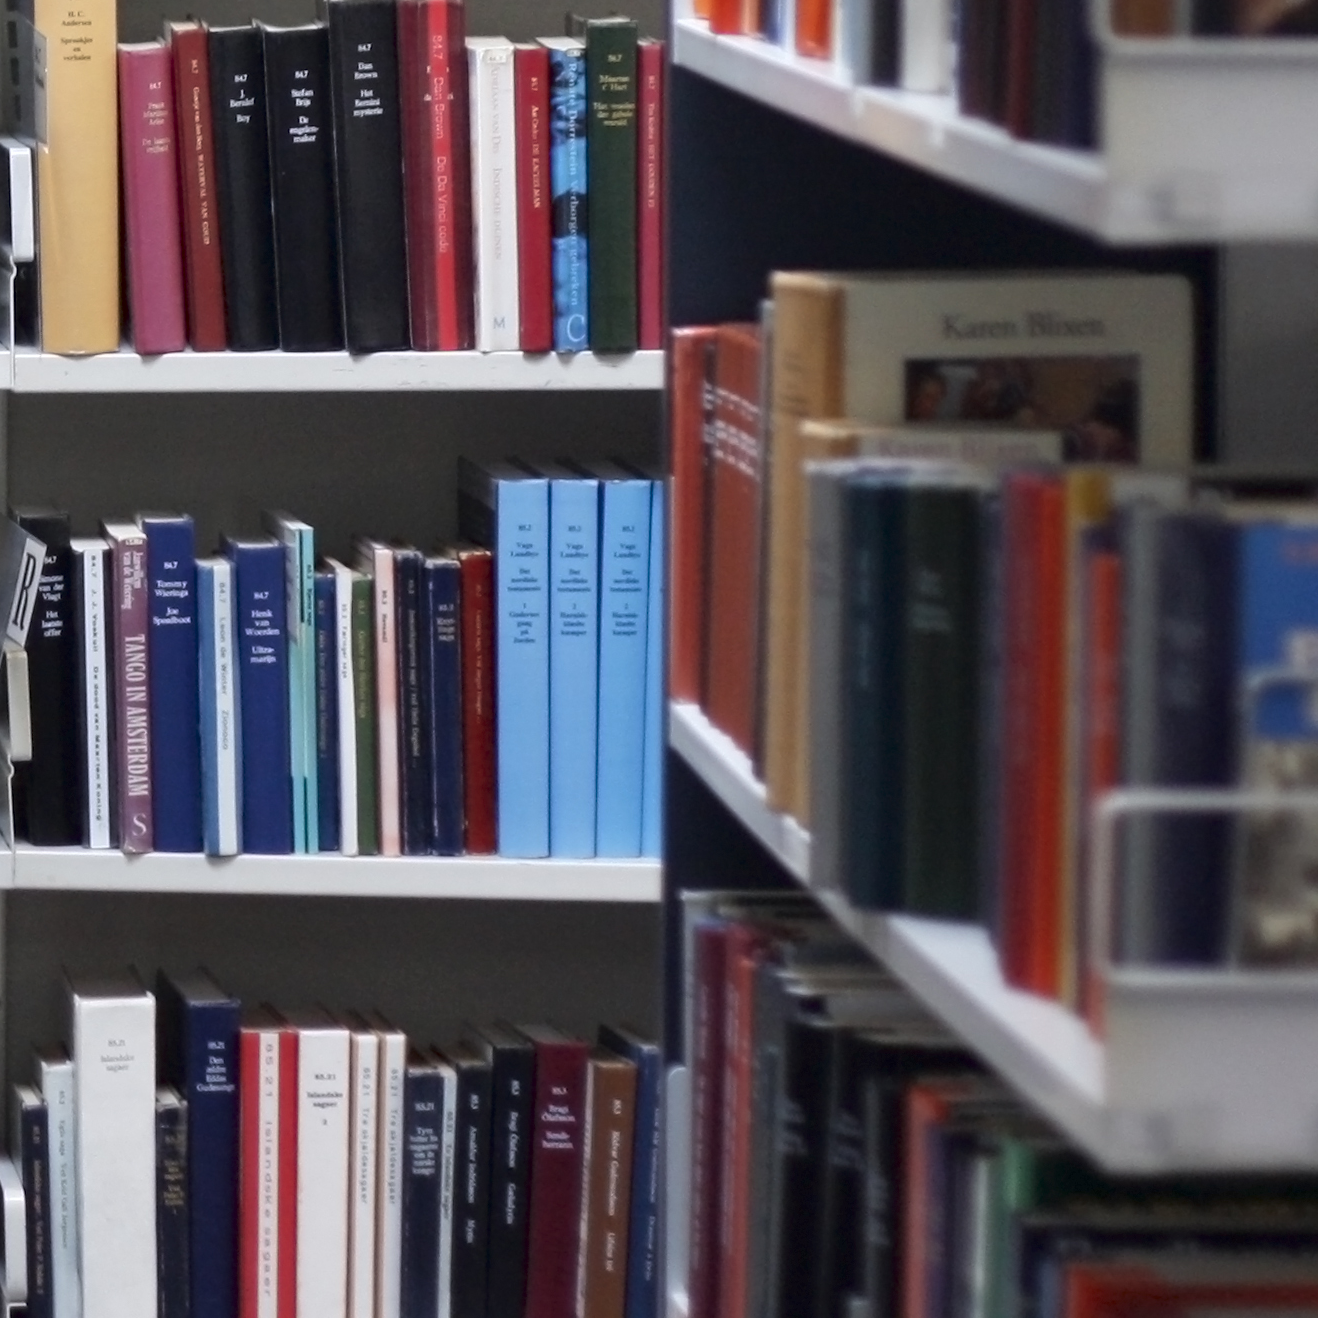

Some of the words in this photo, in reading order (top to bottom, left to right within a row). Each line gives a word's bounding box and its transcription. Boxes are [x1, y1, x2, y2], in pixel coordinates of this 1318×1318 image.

[434, 77, 445, 101] Dan
[435, 104, 445, 139] Brown
[437, 157, 447, 173] De
[438, 195, 448, 223] Vinci
[941, 313, 1018, 340] Karen
[1026, 311, 1105, 338] Blixen
[125, 634, 146, 682] TANGO
[127, 687, 146, 702] IN
[127, 706, 148, 796] AMSTERDAM
